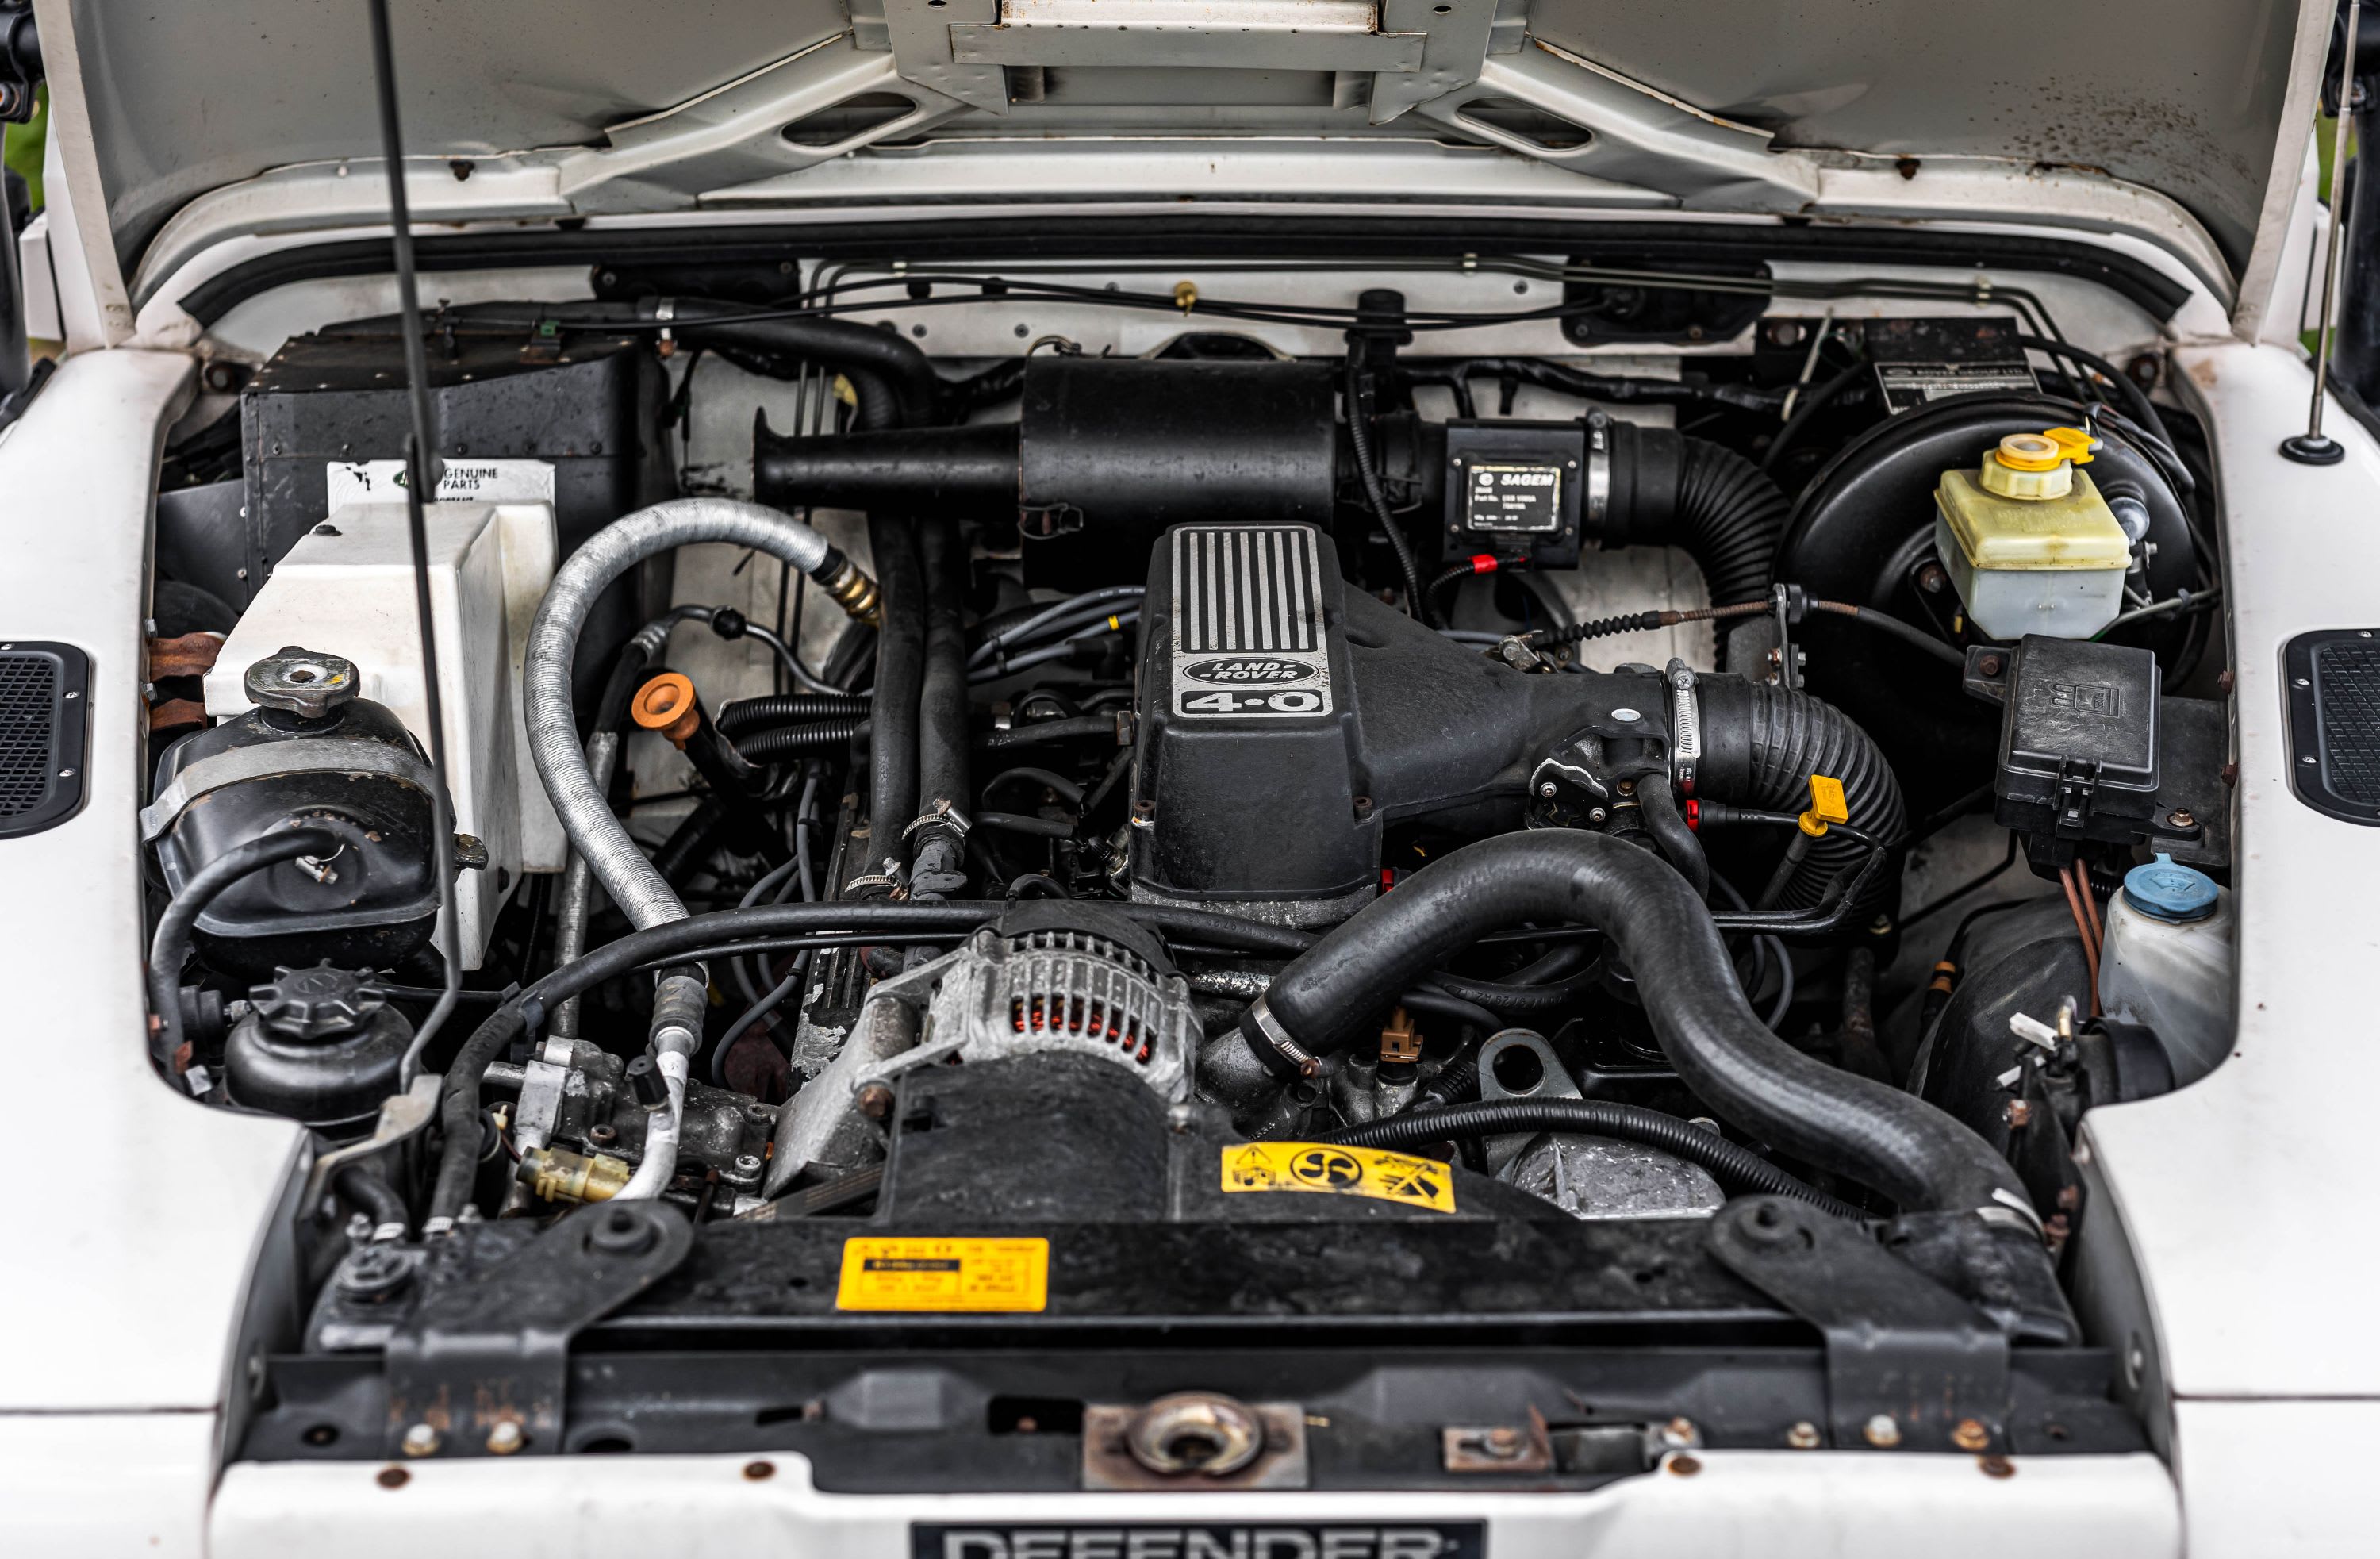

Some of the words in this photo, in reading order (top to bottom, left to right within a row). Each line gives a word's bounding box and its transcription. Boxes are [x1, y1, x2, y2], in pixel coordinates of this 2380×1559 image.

[443, 467, 498, 479] GENUINE
[443, 479, 481, 490] PARTS
[1500, 473, 1555, 486] SAGEM
